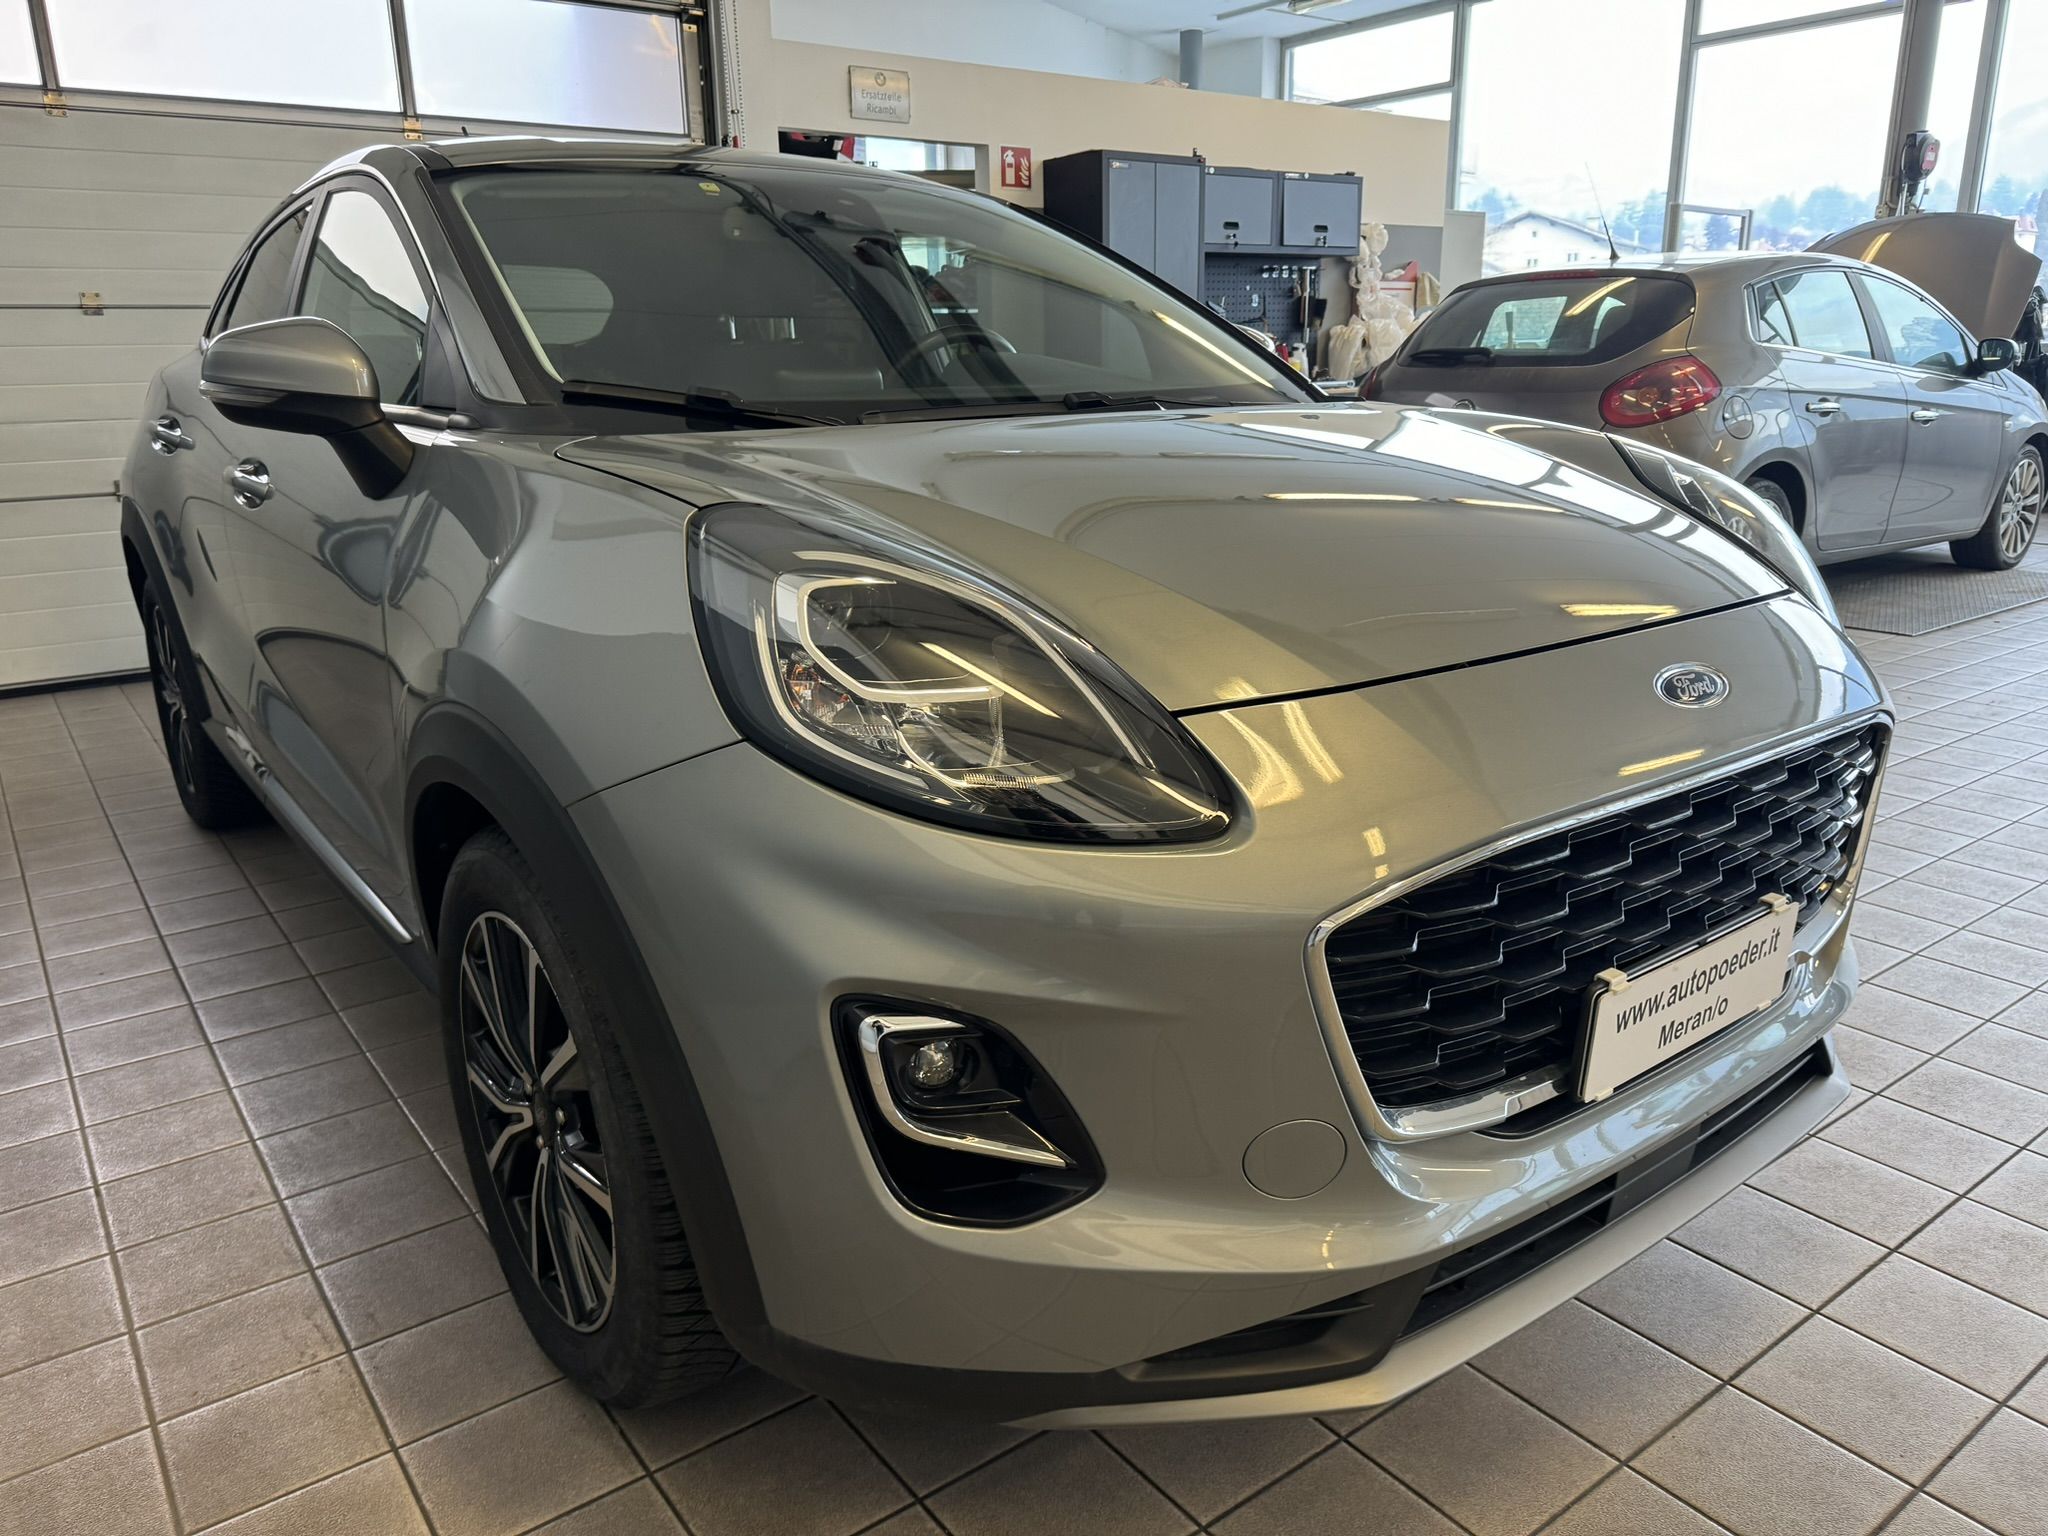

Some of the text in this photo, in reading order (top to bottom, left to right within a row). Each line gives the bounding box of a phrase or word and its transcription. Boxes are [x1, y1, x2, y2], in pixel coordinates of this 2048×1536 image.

[861, 88, 903, 103] Ersatzteile
[866, 102, 897, 115] Ricambi
[1673, 673, 1715, 701] Ford
[1615, 927, 1781, 1034] www.autopoeder.it
[1657, 994, 1729, 1049] Meran/o
